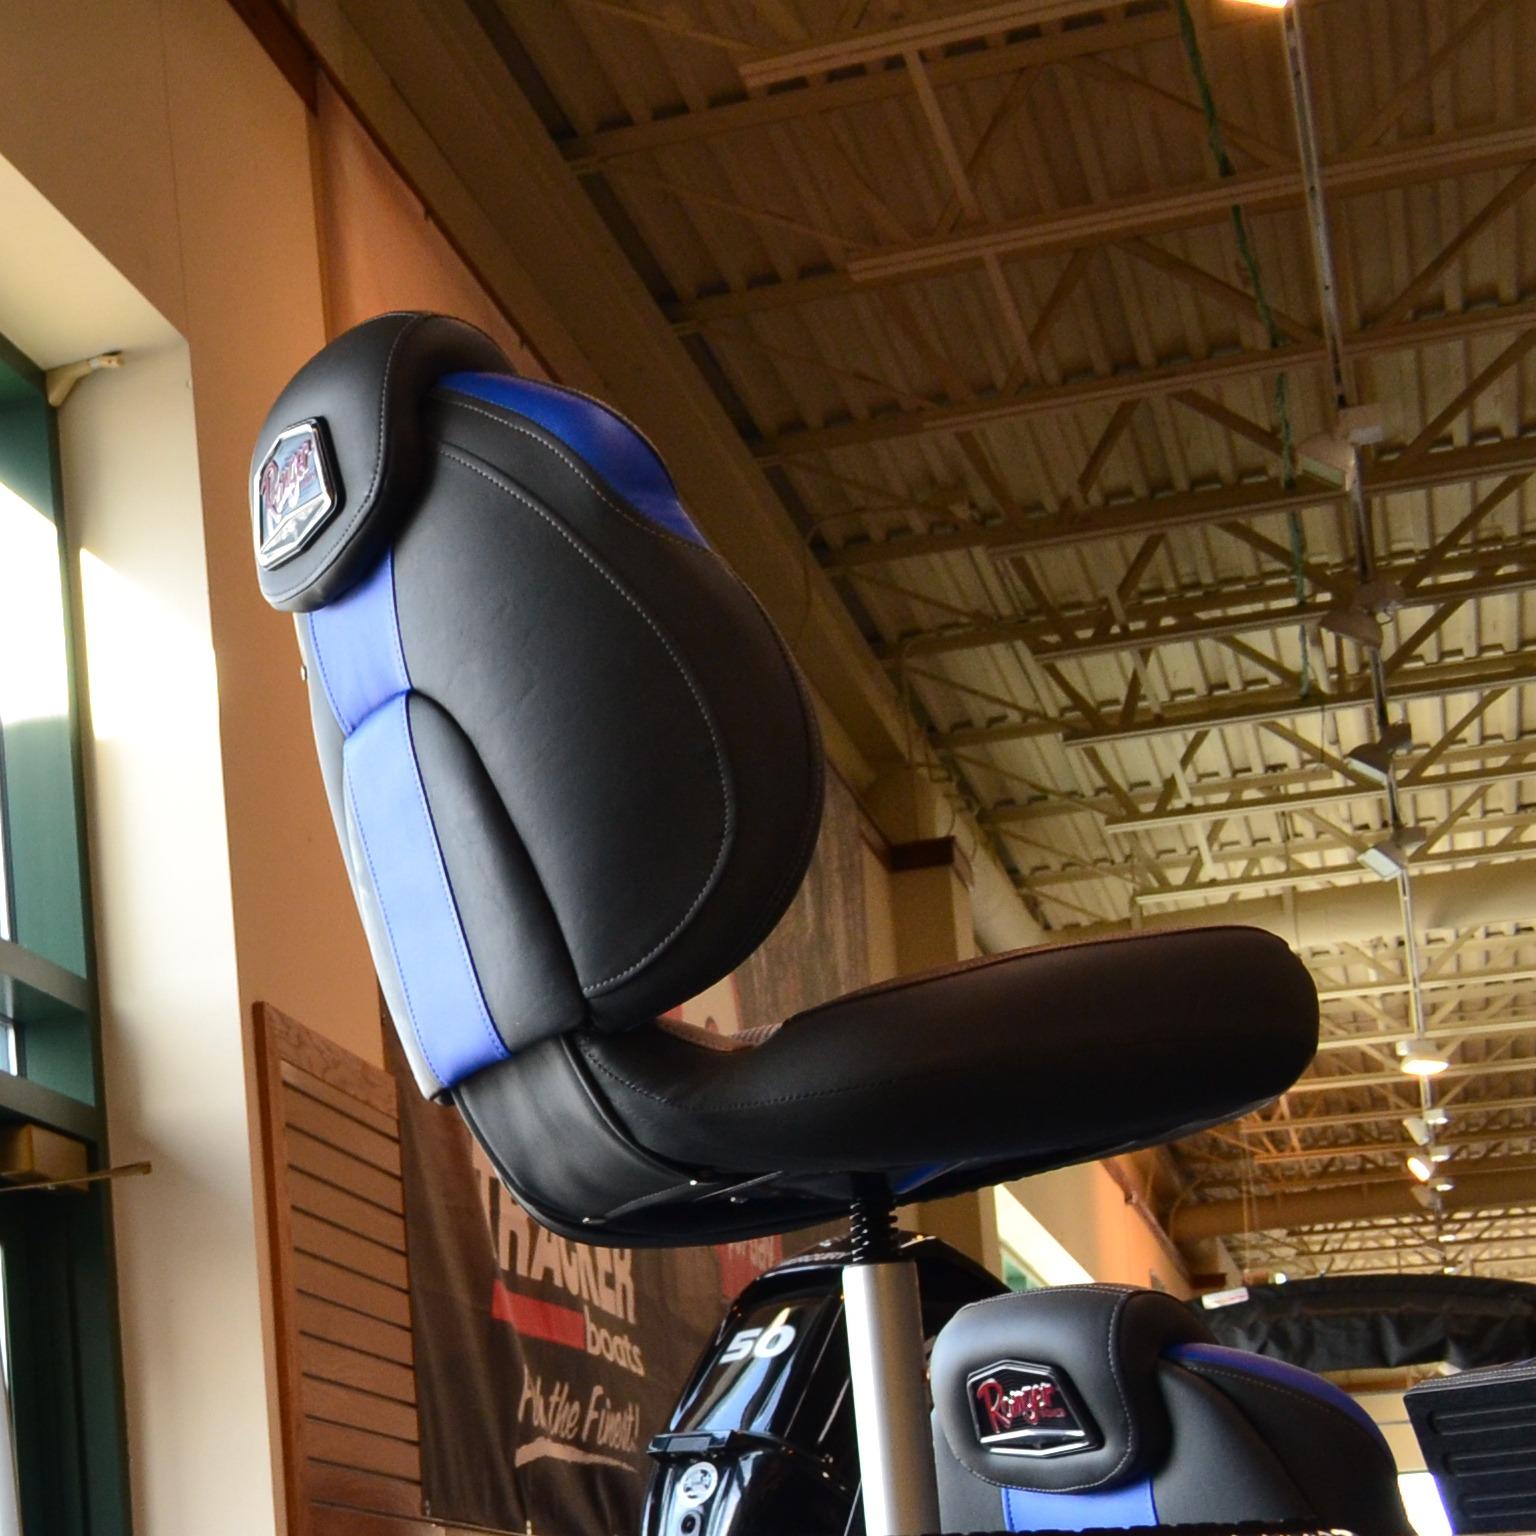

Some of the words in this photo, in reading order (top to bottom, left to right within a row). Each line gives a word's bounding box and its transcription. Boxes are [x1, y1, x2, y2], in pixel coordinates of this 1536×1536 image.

[584, 1304, 646, 1377] boats
[718, 1324, 797, 1366] 50
[976, 1377, 1055, 1434] Ranger
